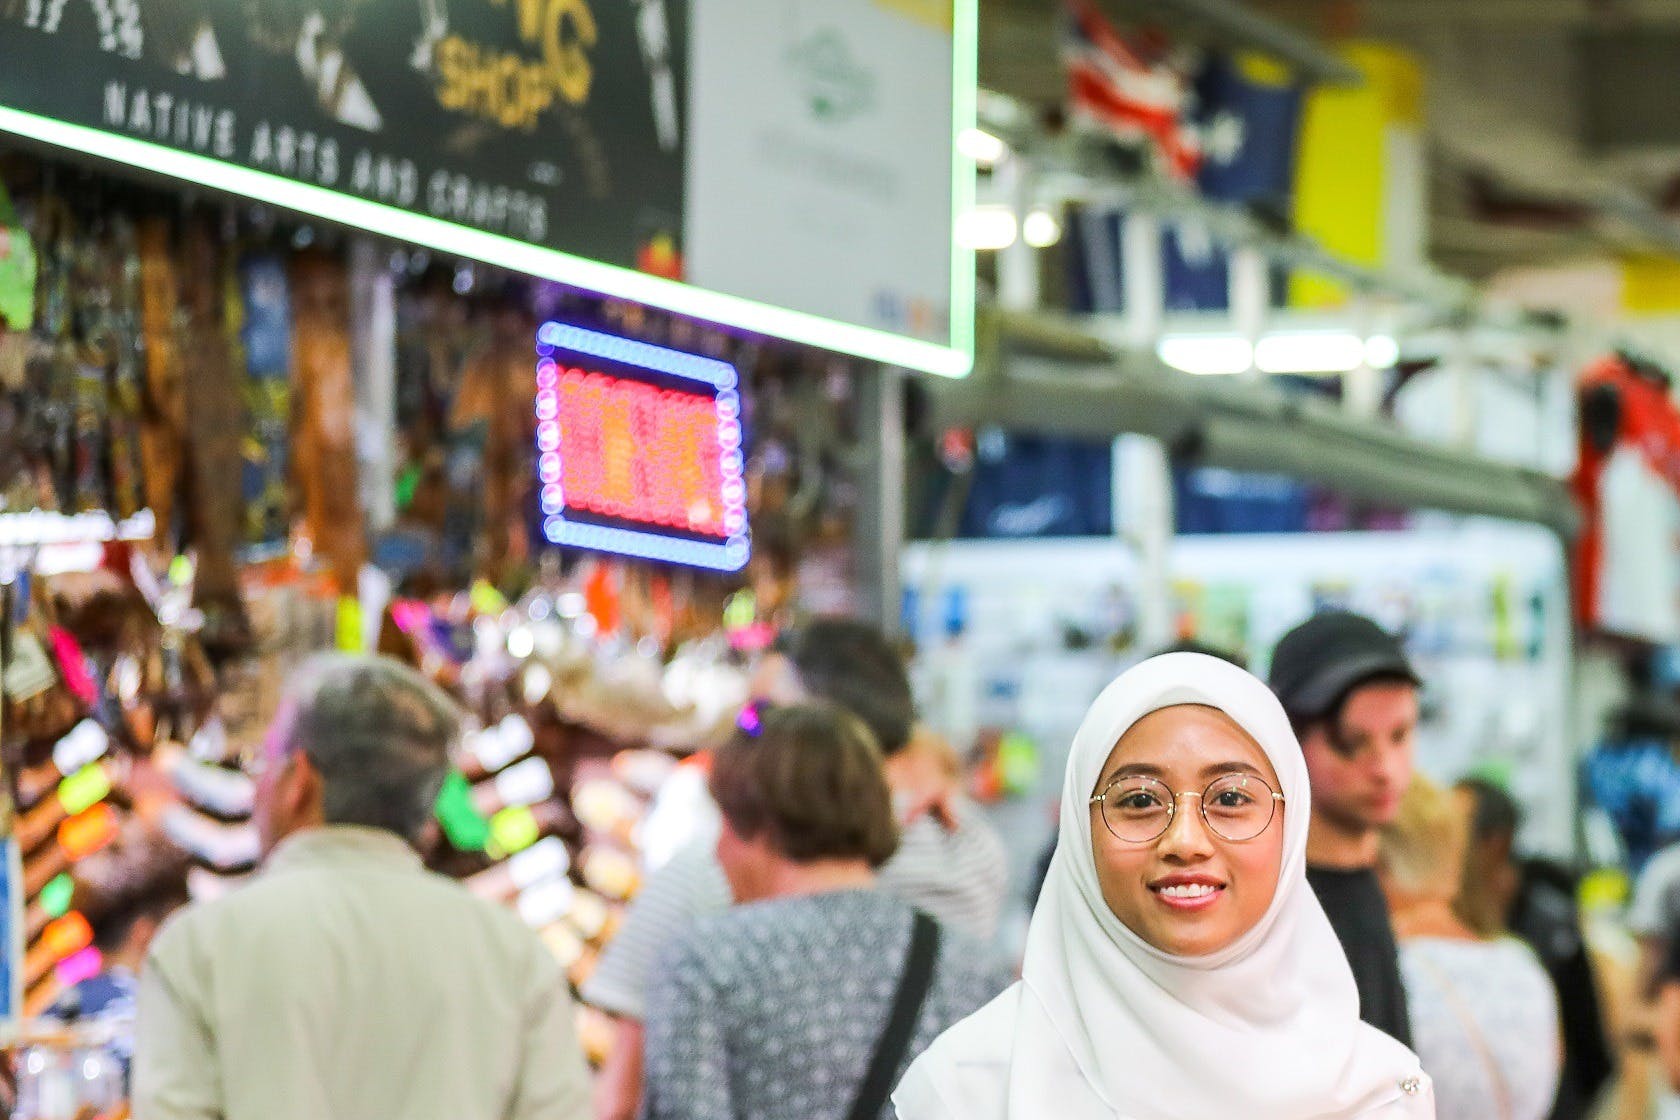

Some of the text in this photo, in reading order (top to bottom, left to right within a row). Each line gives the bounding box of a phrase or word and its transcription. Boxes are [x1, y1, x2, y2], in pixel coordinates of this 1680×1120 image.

[436, 35, 551, 134] SHOP
[103, 80, 548, 241] NATIVE ARTS AND CRAFTS
